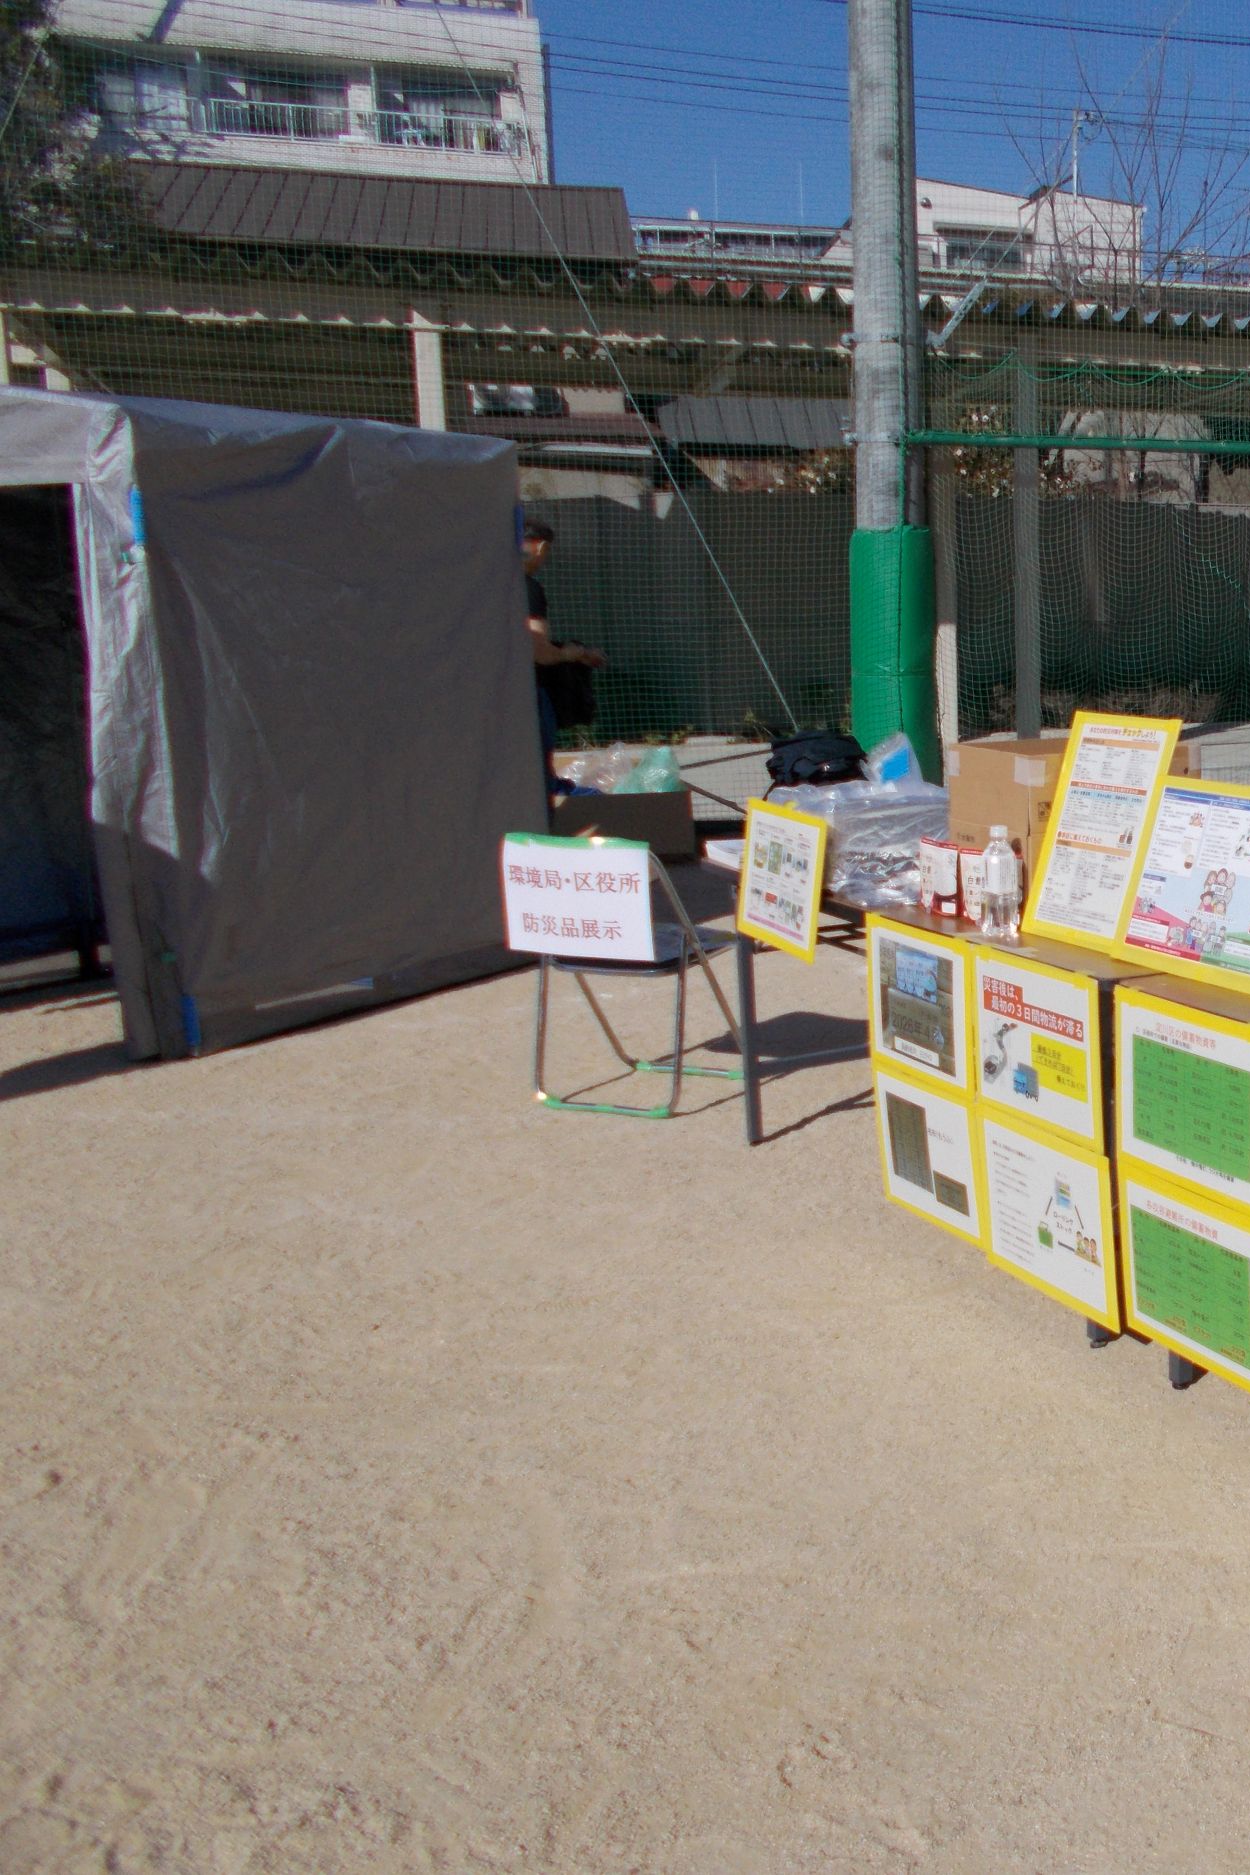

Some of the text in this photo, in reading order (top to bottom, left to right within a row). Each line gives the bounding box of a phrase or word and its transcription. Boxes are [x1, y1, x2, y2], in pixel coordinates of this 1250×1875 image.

[508, 864, 640, 894] 環境局・区役所
[522, 912, 622, 940] 防災品展示
[983, 977, 1019, 1001] 災害後は、
[1053, 1211, 1074, 1225] ローリング
